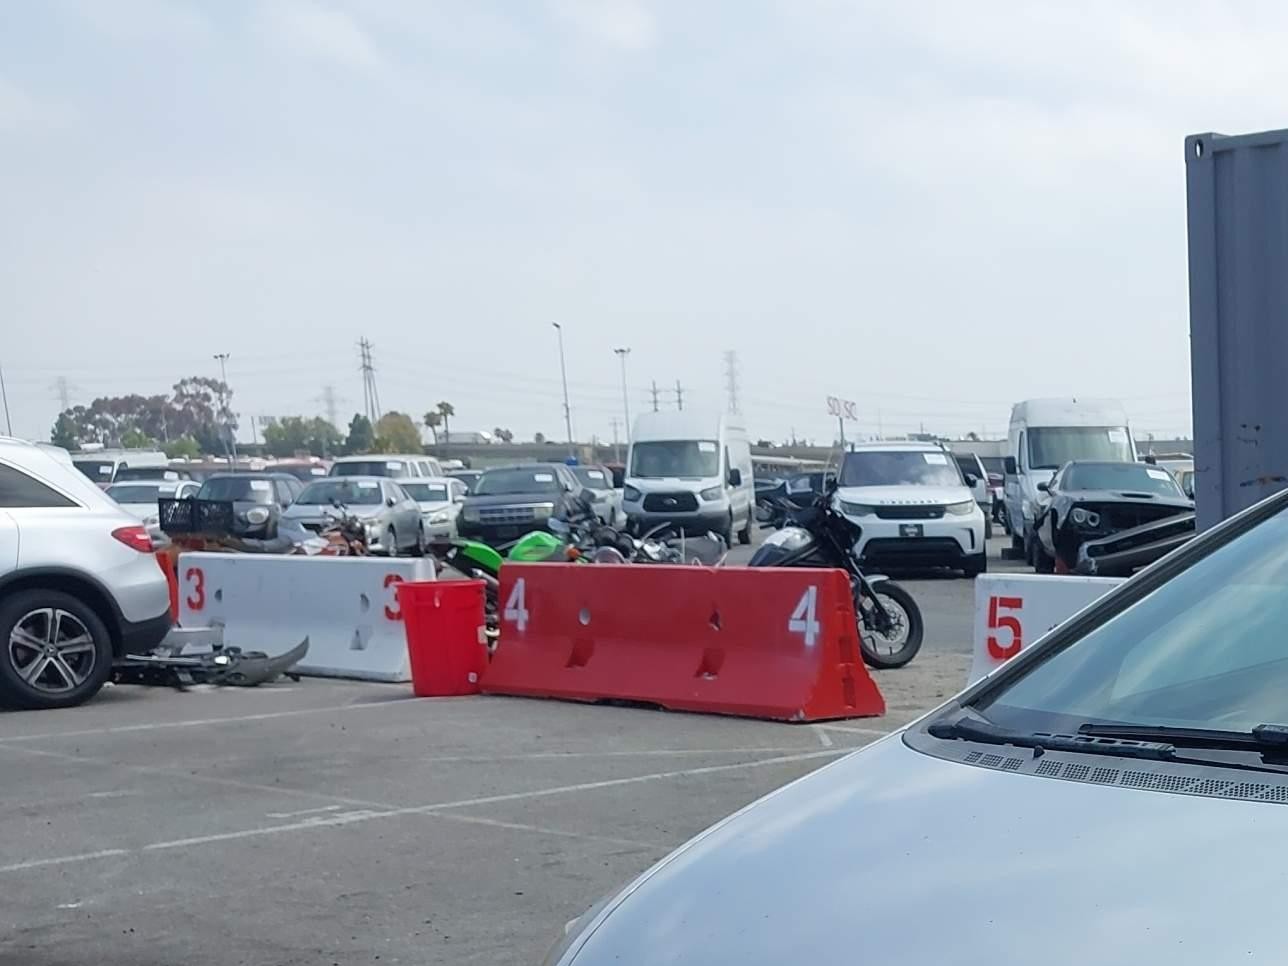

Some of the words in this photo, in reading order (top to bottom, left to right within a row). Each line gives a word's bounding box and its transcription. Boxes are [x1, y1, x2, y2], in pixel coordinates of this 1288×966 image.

[186, 567, 205, 611] 3
[384, 574, 403, 621] 3
[504, 578, 529, 632] 4
[788, 585, 820, 647] 4
[987, 597, 1022, 661] 5
